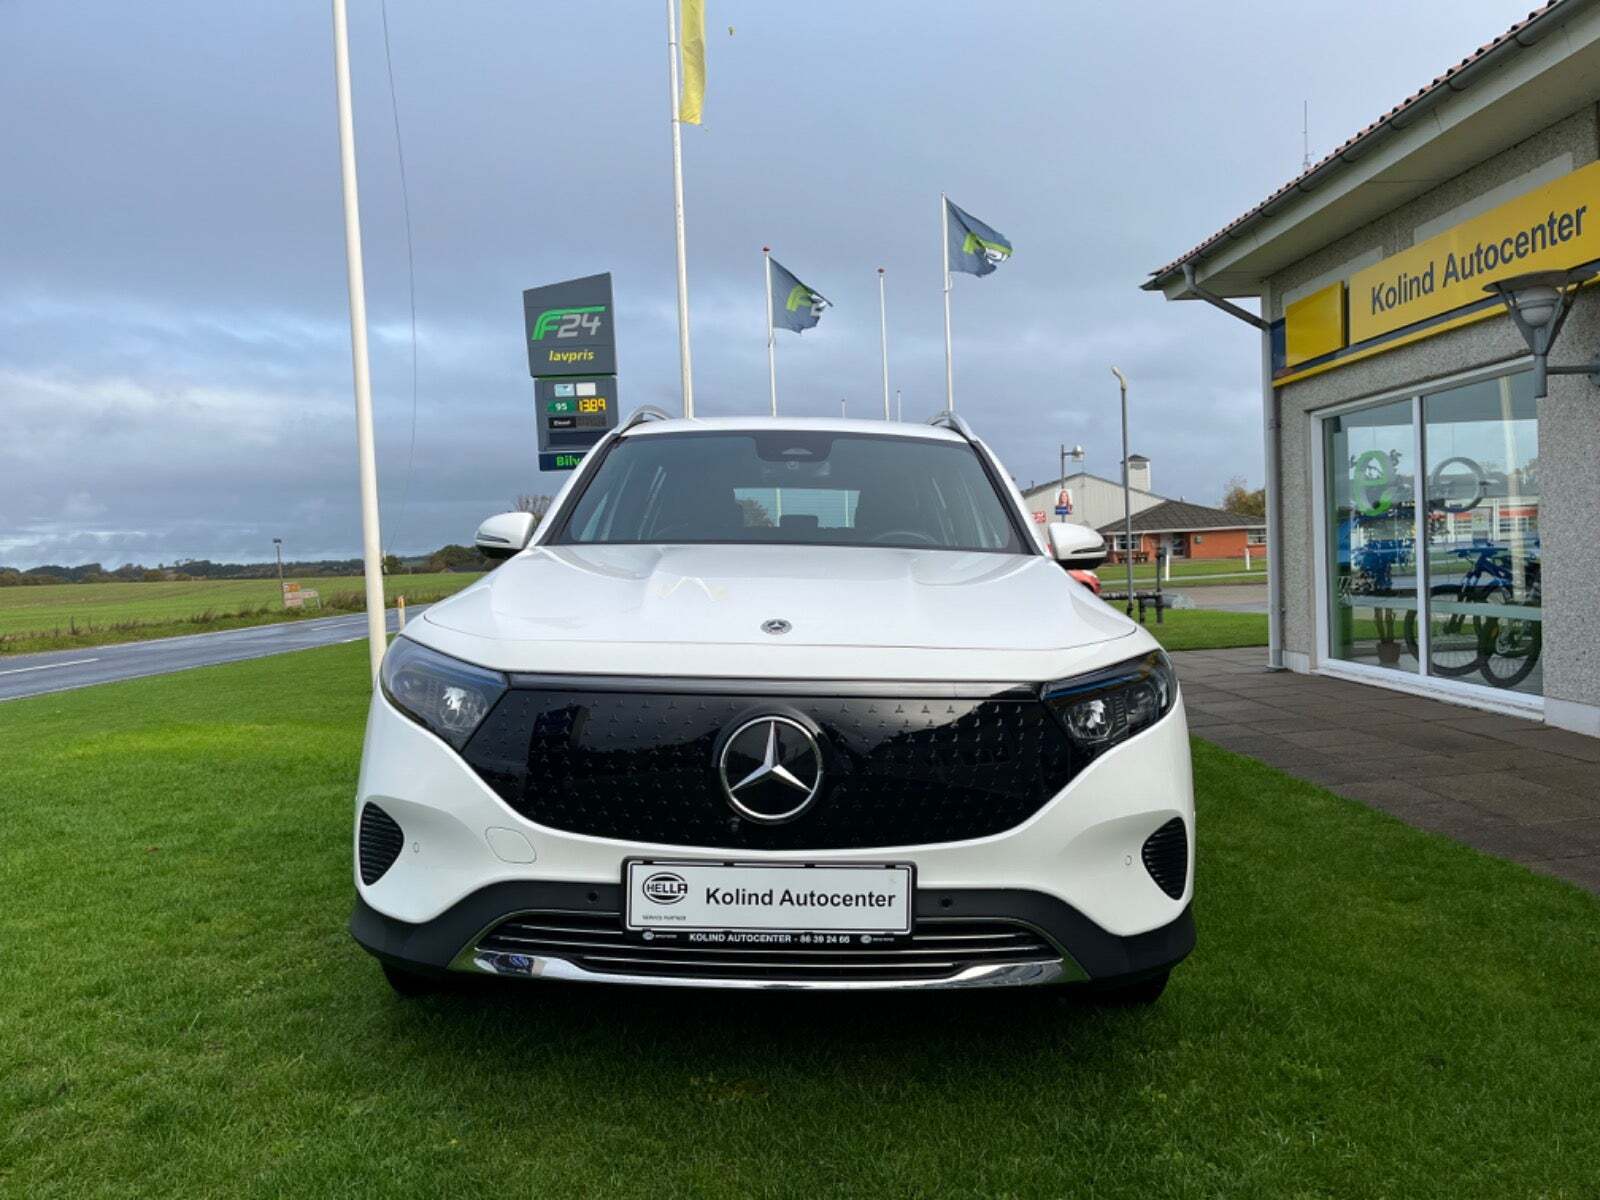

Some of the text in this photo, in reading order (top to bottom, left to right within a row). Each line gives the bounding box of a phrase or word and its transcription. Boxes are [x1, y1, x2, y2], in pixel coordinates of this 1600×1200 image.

[1371, 204, 1587, 315] Kolind Autocenter
[532, 306, 606, 341] F24
[549, 350, 594, 363] lavpris
[554, 402, 567, 411] 95
[646, 883, 688, 894] HELLA
[705, 887, 896, 908] Kolind Autocenter
[689, 933, 725, 943] KOLIND
[727, 933, 792, 943] AUTOCENTER
[826, 935, 837, 944] 24
